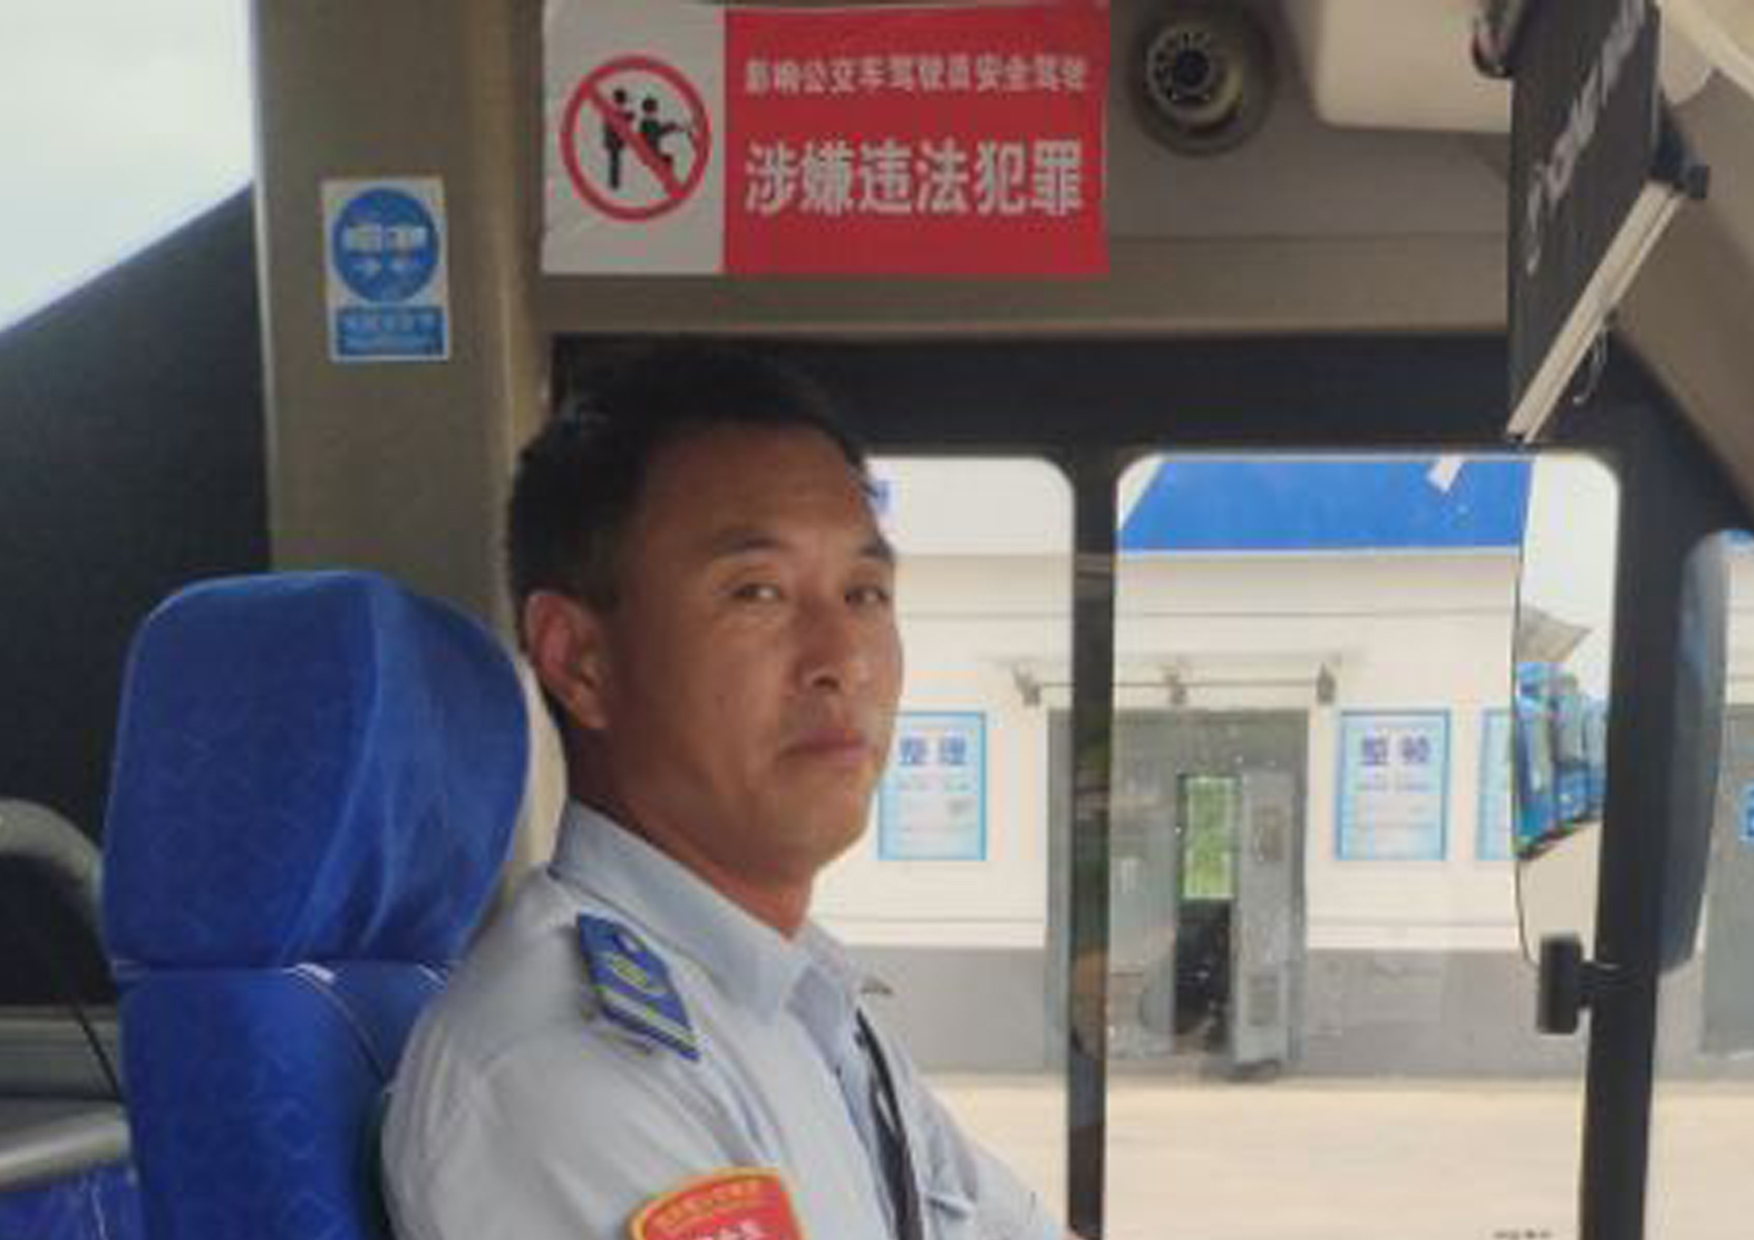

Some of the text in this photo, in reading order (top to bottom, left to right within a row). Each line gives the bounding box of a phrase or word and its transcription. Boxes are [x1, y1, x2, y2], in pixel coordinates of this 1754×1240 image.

[745, 51, 1089, 94] 影响公交车驾驶员安全驾驶
[745, 138, 1083, 217] 涉嫌违法犯罪
